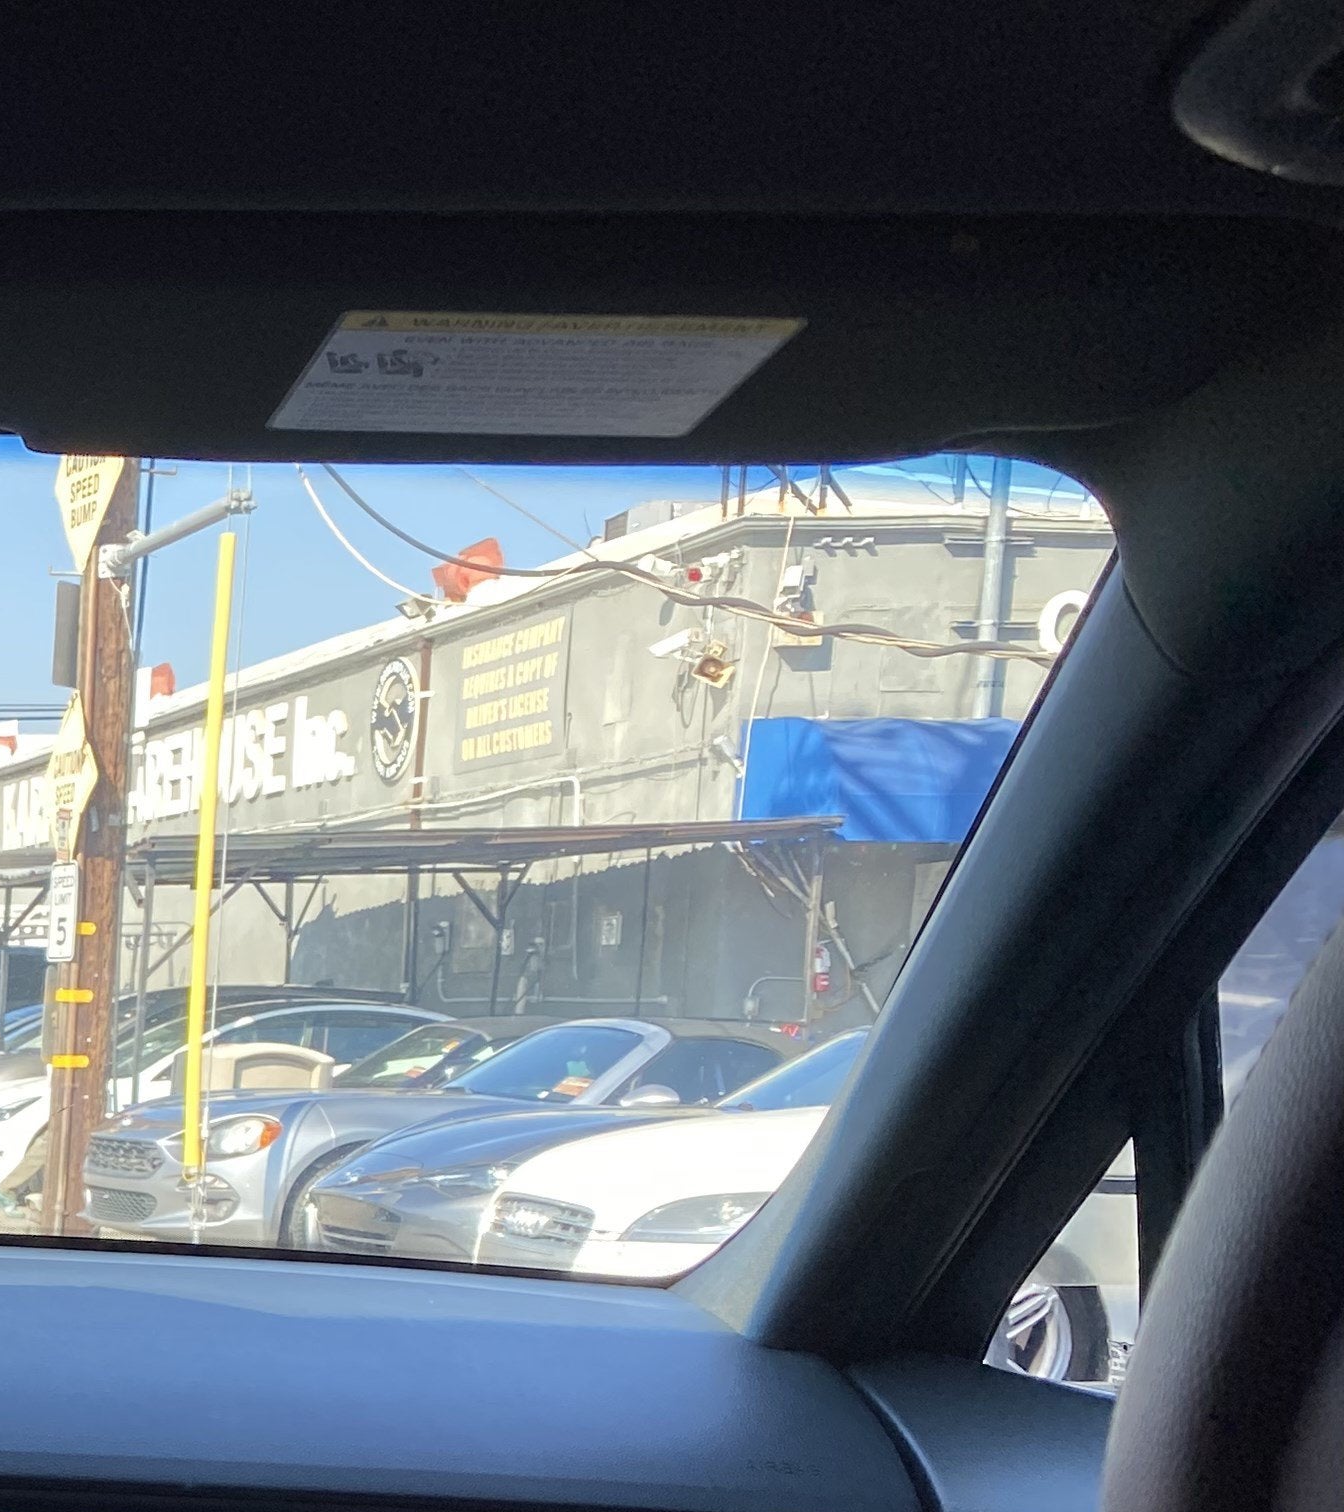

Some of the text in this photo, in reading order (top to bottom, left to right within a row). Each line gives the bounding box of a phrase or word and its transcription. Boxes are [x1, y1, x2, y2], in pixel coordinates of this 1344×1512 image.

[70, 473, 100, 503] SPEED
[70, 501, 97, 529] BUMP
[515, 657, 544, 686] COPY
[544, 651, 559, 679] OF
[53, 874, 75, 890] SPEED
[54, 891, 73, 907] LIMIT
[56, 916, 67, 946] 5
